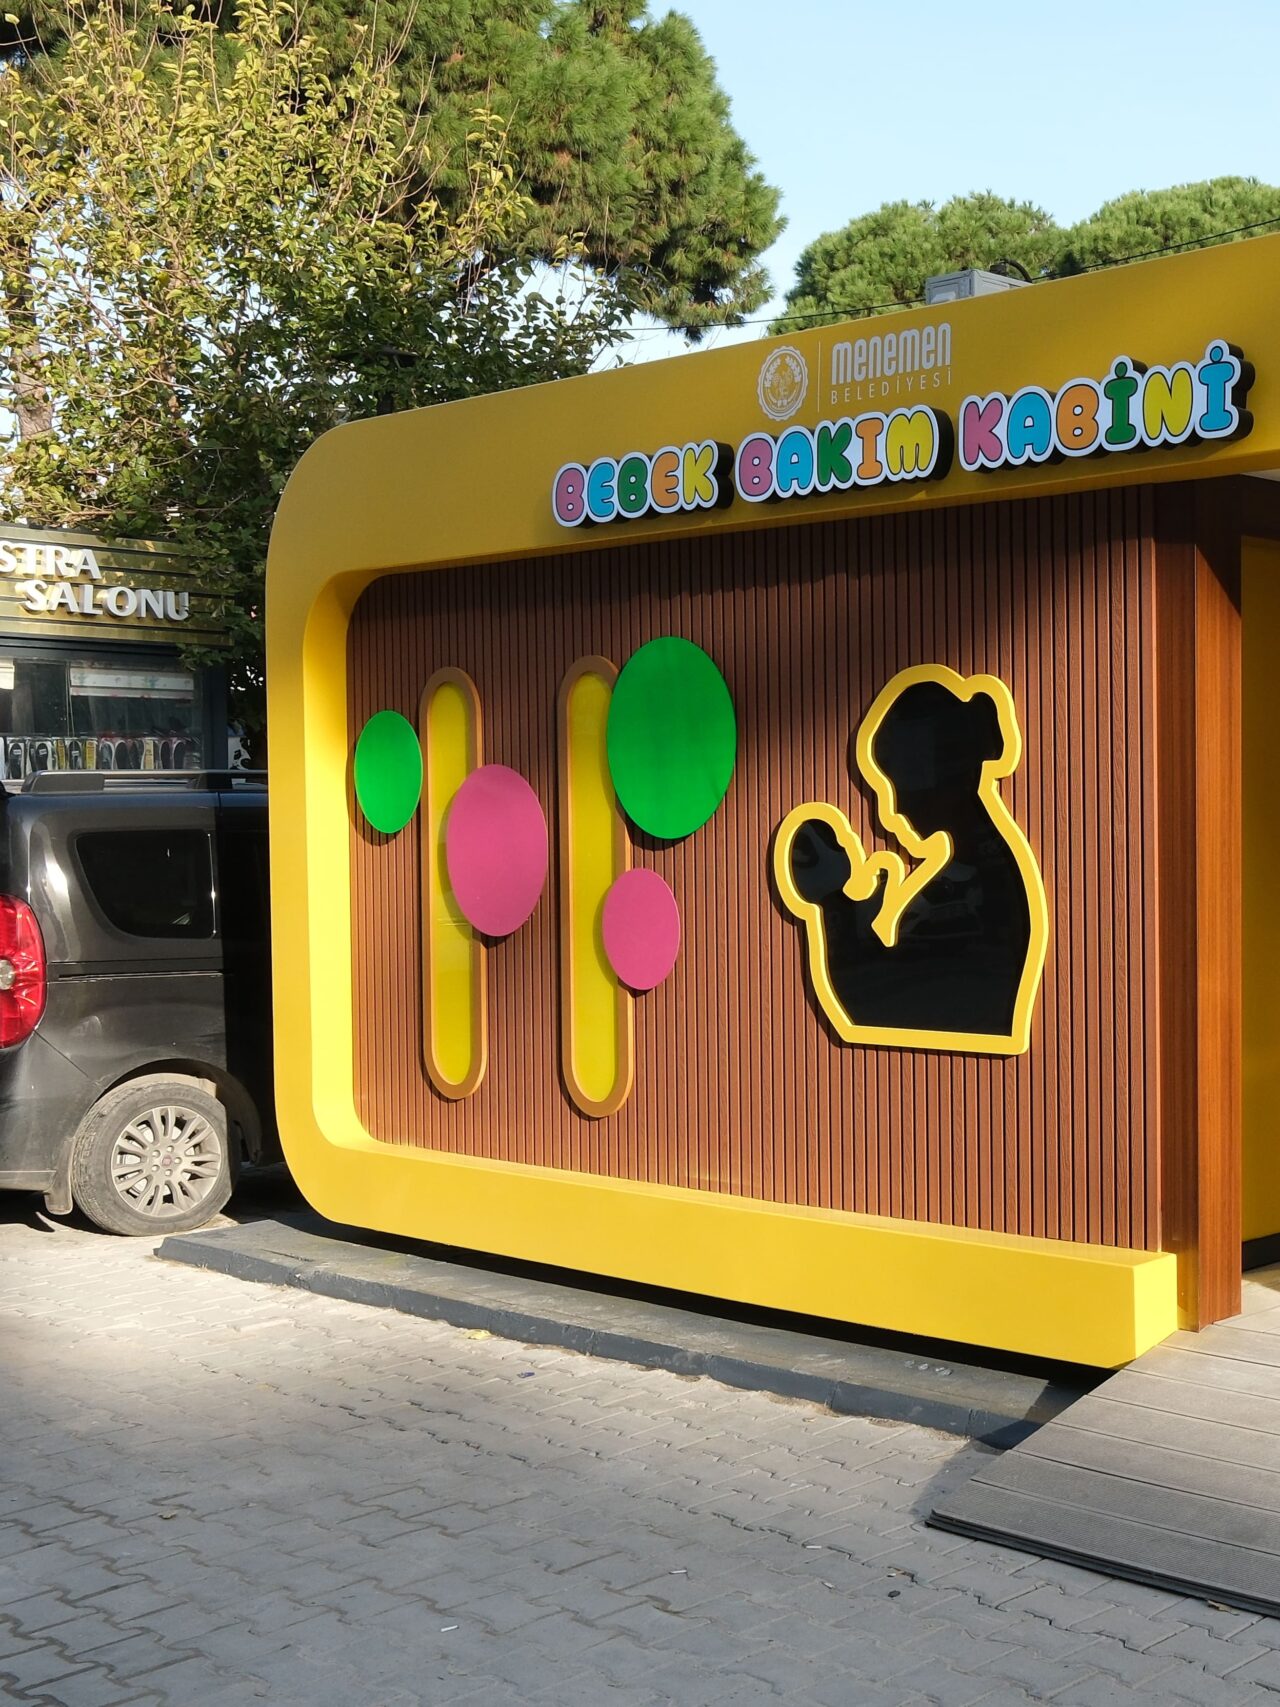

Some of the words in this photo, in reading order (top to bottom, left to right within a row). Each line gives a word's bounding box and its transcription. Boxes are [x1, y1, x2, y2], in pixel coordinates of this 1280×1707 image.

[831, 367, 951, 405] BELEDİYESİ
[551, 438, 720, 528] BEBEK
[735, 404, 940, 503] BAKIM
[959, 338, 1243, 472] KABİNİ
[0, 540, 102, 580] STRA
[20, 579, 190, 621] SALONU
